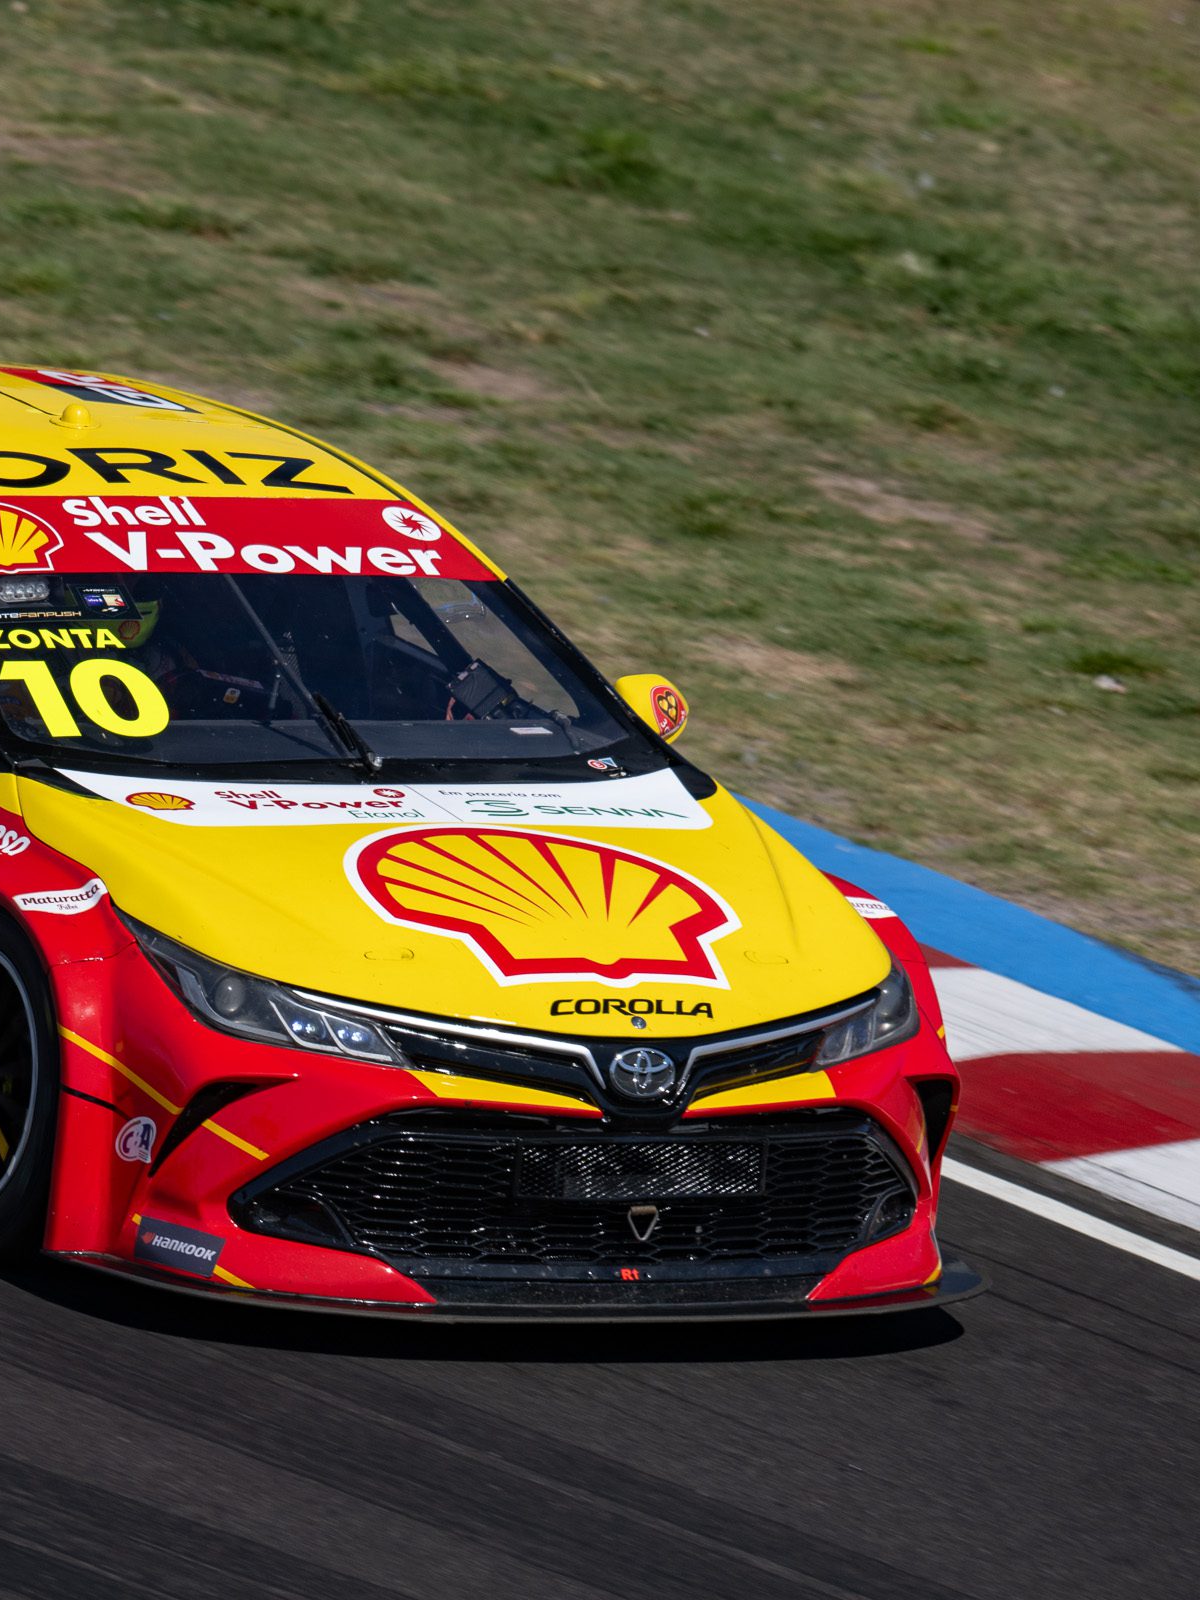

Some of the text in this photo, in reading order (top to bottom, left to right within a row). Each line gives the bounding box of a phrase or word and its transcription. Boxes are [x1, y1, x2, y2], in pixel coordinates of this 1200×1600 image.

[62, 496, 207, 527] Shell
[83, 530, 442, 577] V-Power
[214, 790, 282, 799] Shell
[226, 799, 404, 810] V-Power
[348, 808, 425, 818] Etanol
[534, 804, 689, 819] SENNA
[21, 884, 100, 906] Maturatta
[550, 999, 714, 1018] COROLLA
